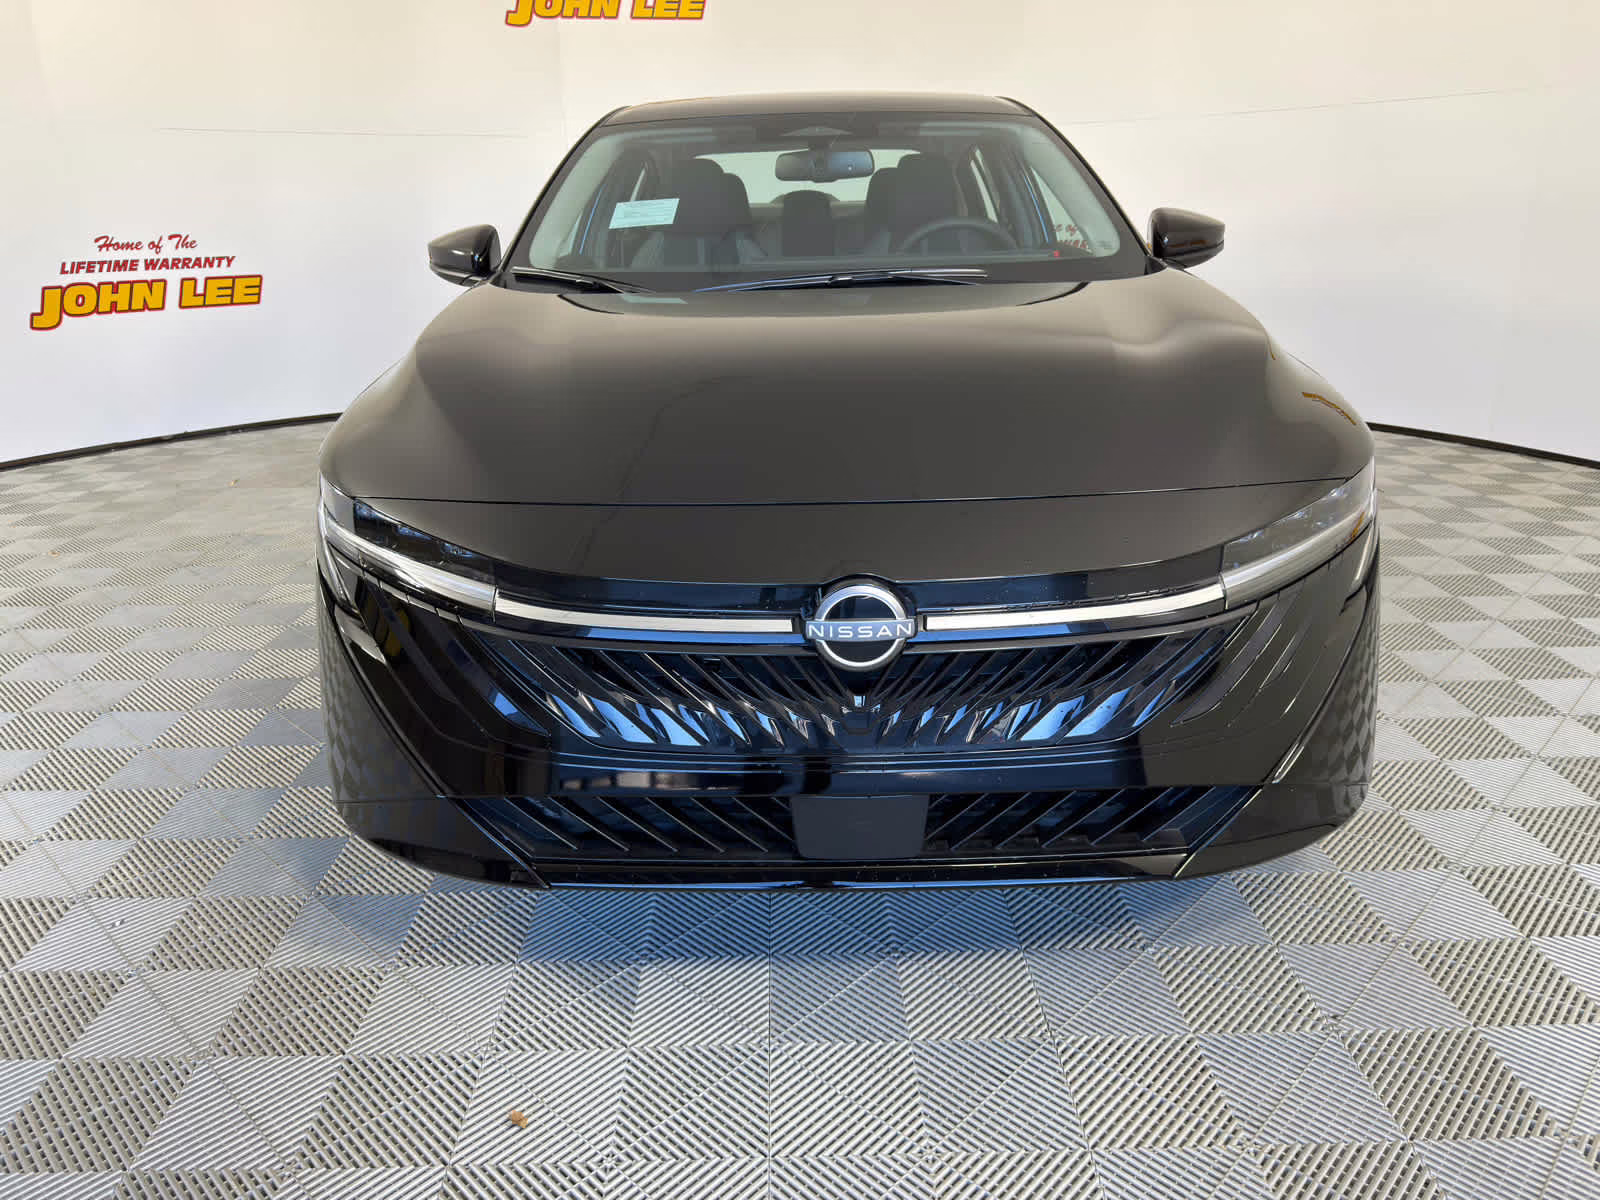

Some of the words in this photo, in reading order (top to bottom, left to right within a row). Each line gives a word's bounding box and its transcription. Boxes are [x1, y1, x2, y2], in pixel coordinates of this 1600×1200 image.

[505, 0, 622, 27] JOHN
[630, 0, 706, 19] LEE
[94, 235, 143, 252] Home
[147, 236, 163, 254] of
[168, 234, 198, 249] The
[60, 258, 140, 275] LIFETIME
[143, 256, 236, 271] WARRANTY
[30, 279, 167, 330] JOHN
[179, 275, 263, 309] LEE
[808, 622, 913, 638] NISSAN
